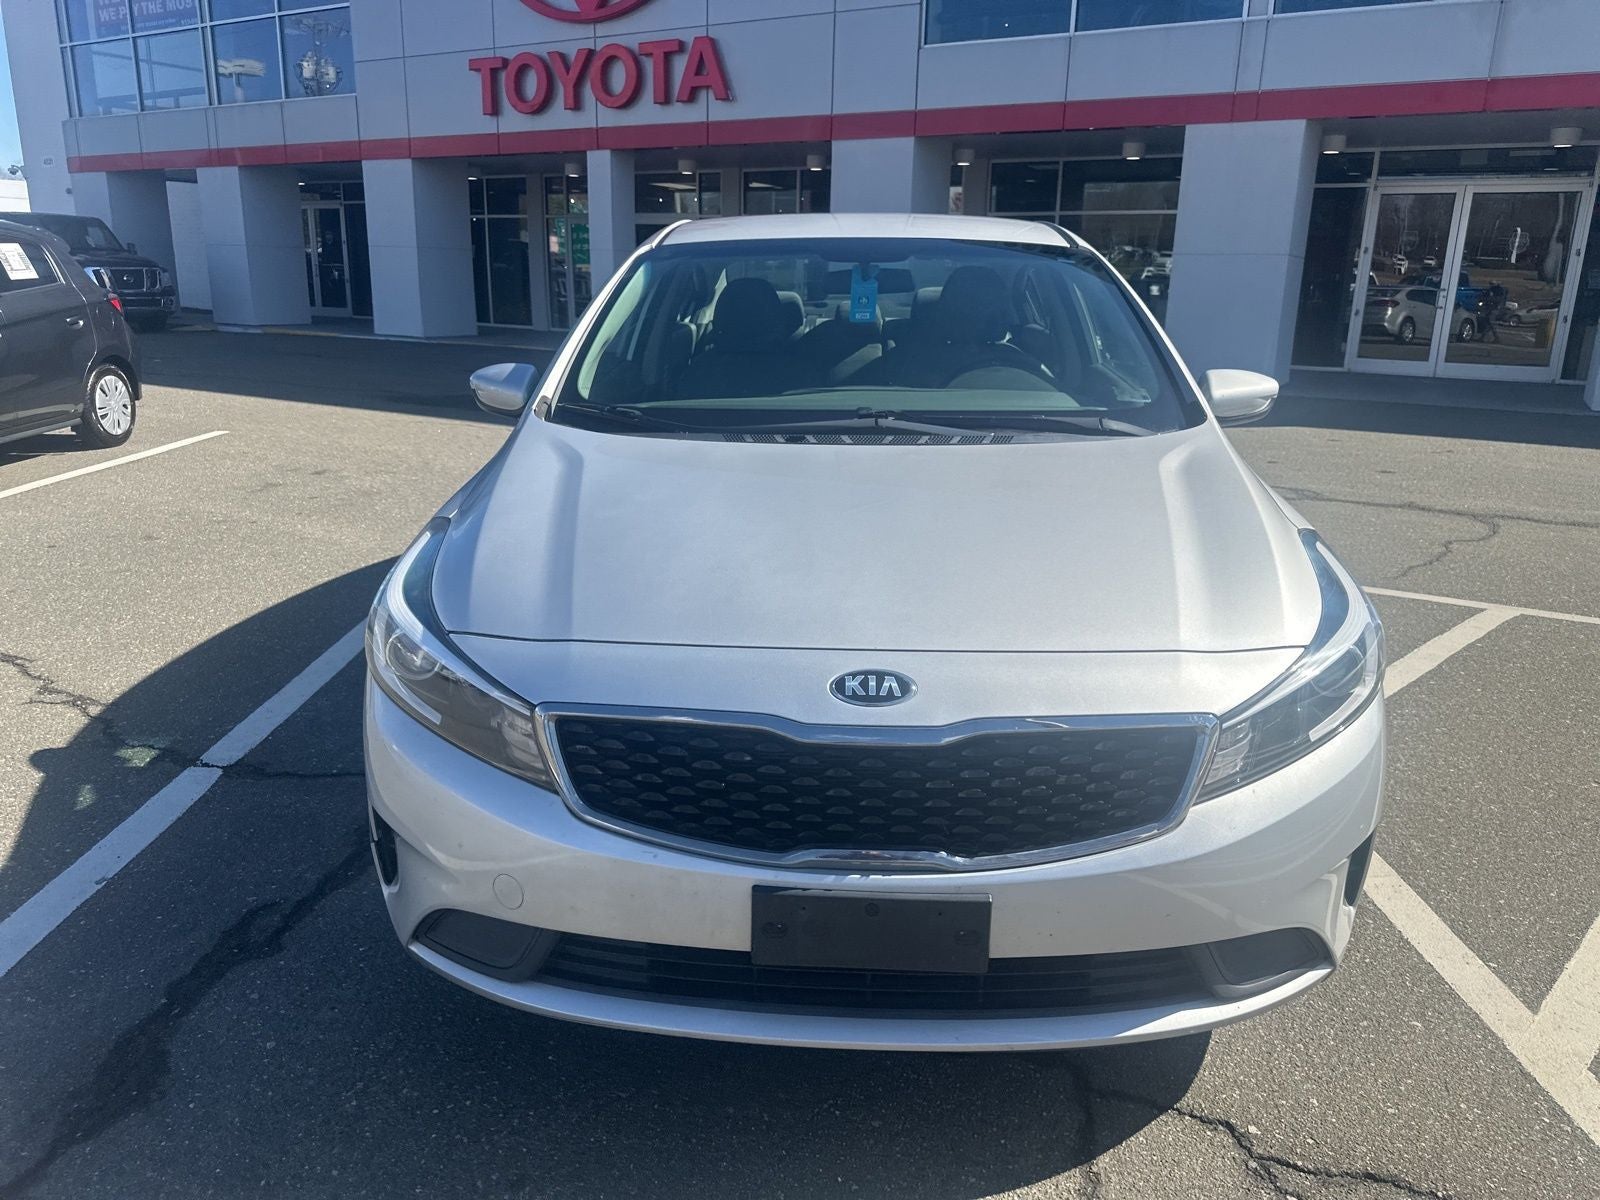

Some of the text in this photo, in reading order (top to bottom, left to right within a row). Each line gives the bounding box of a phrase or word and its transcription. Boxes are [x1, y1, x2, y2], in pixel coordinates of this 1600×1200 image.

[98, 8, 117, 21] WE
[119, 3, 139, 19] PY
[141, 0, 164, 15] THE
[166, 0, 195, 11] MOS
[469, 36, 731, 116] TOYOTA
[844, 675, 902, 697] KIA
